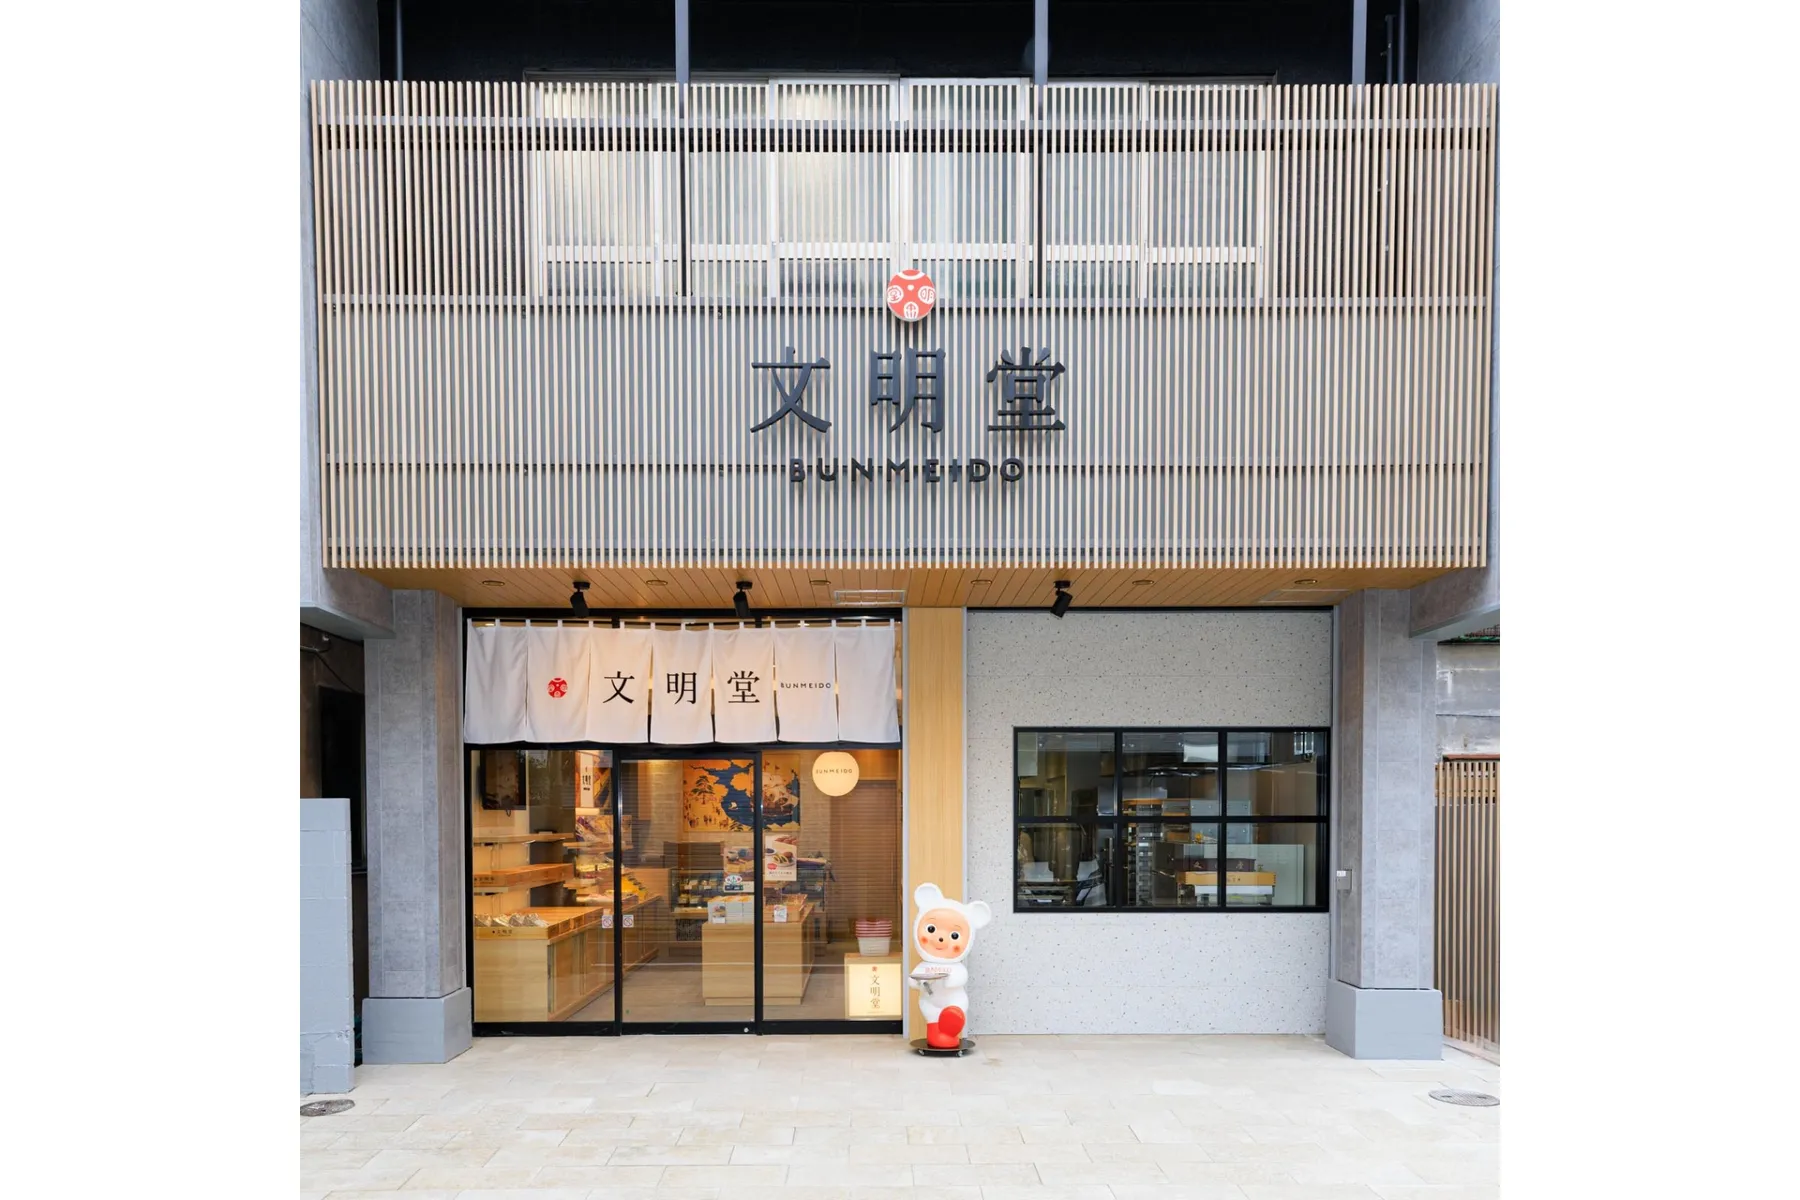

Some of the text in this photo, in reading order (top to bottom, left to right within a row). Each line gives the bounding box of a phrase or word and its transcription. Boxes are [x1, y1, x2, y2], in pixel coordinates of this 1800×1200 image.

[750, 346, 1066, 433] 文明堂
[789, 458, 1024, 483] BUNMEIDO
[602, 670, 760, 705] 文明堂
[869, 974, 881, 1009] 文明堂
